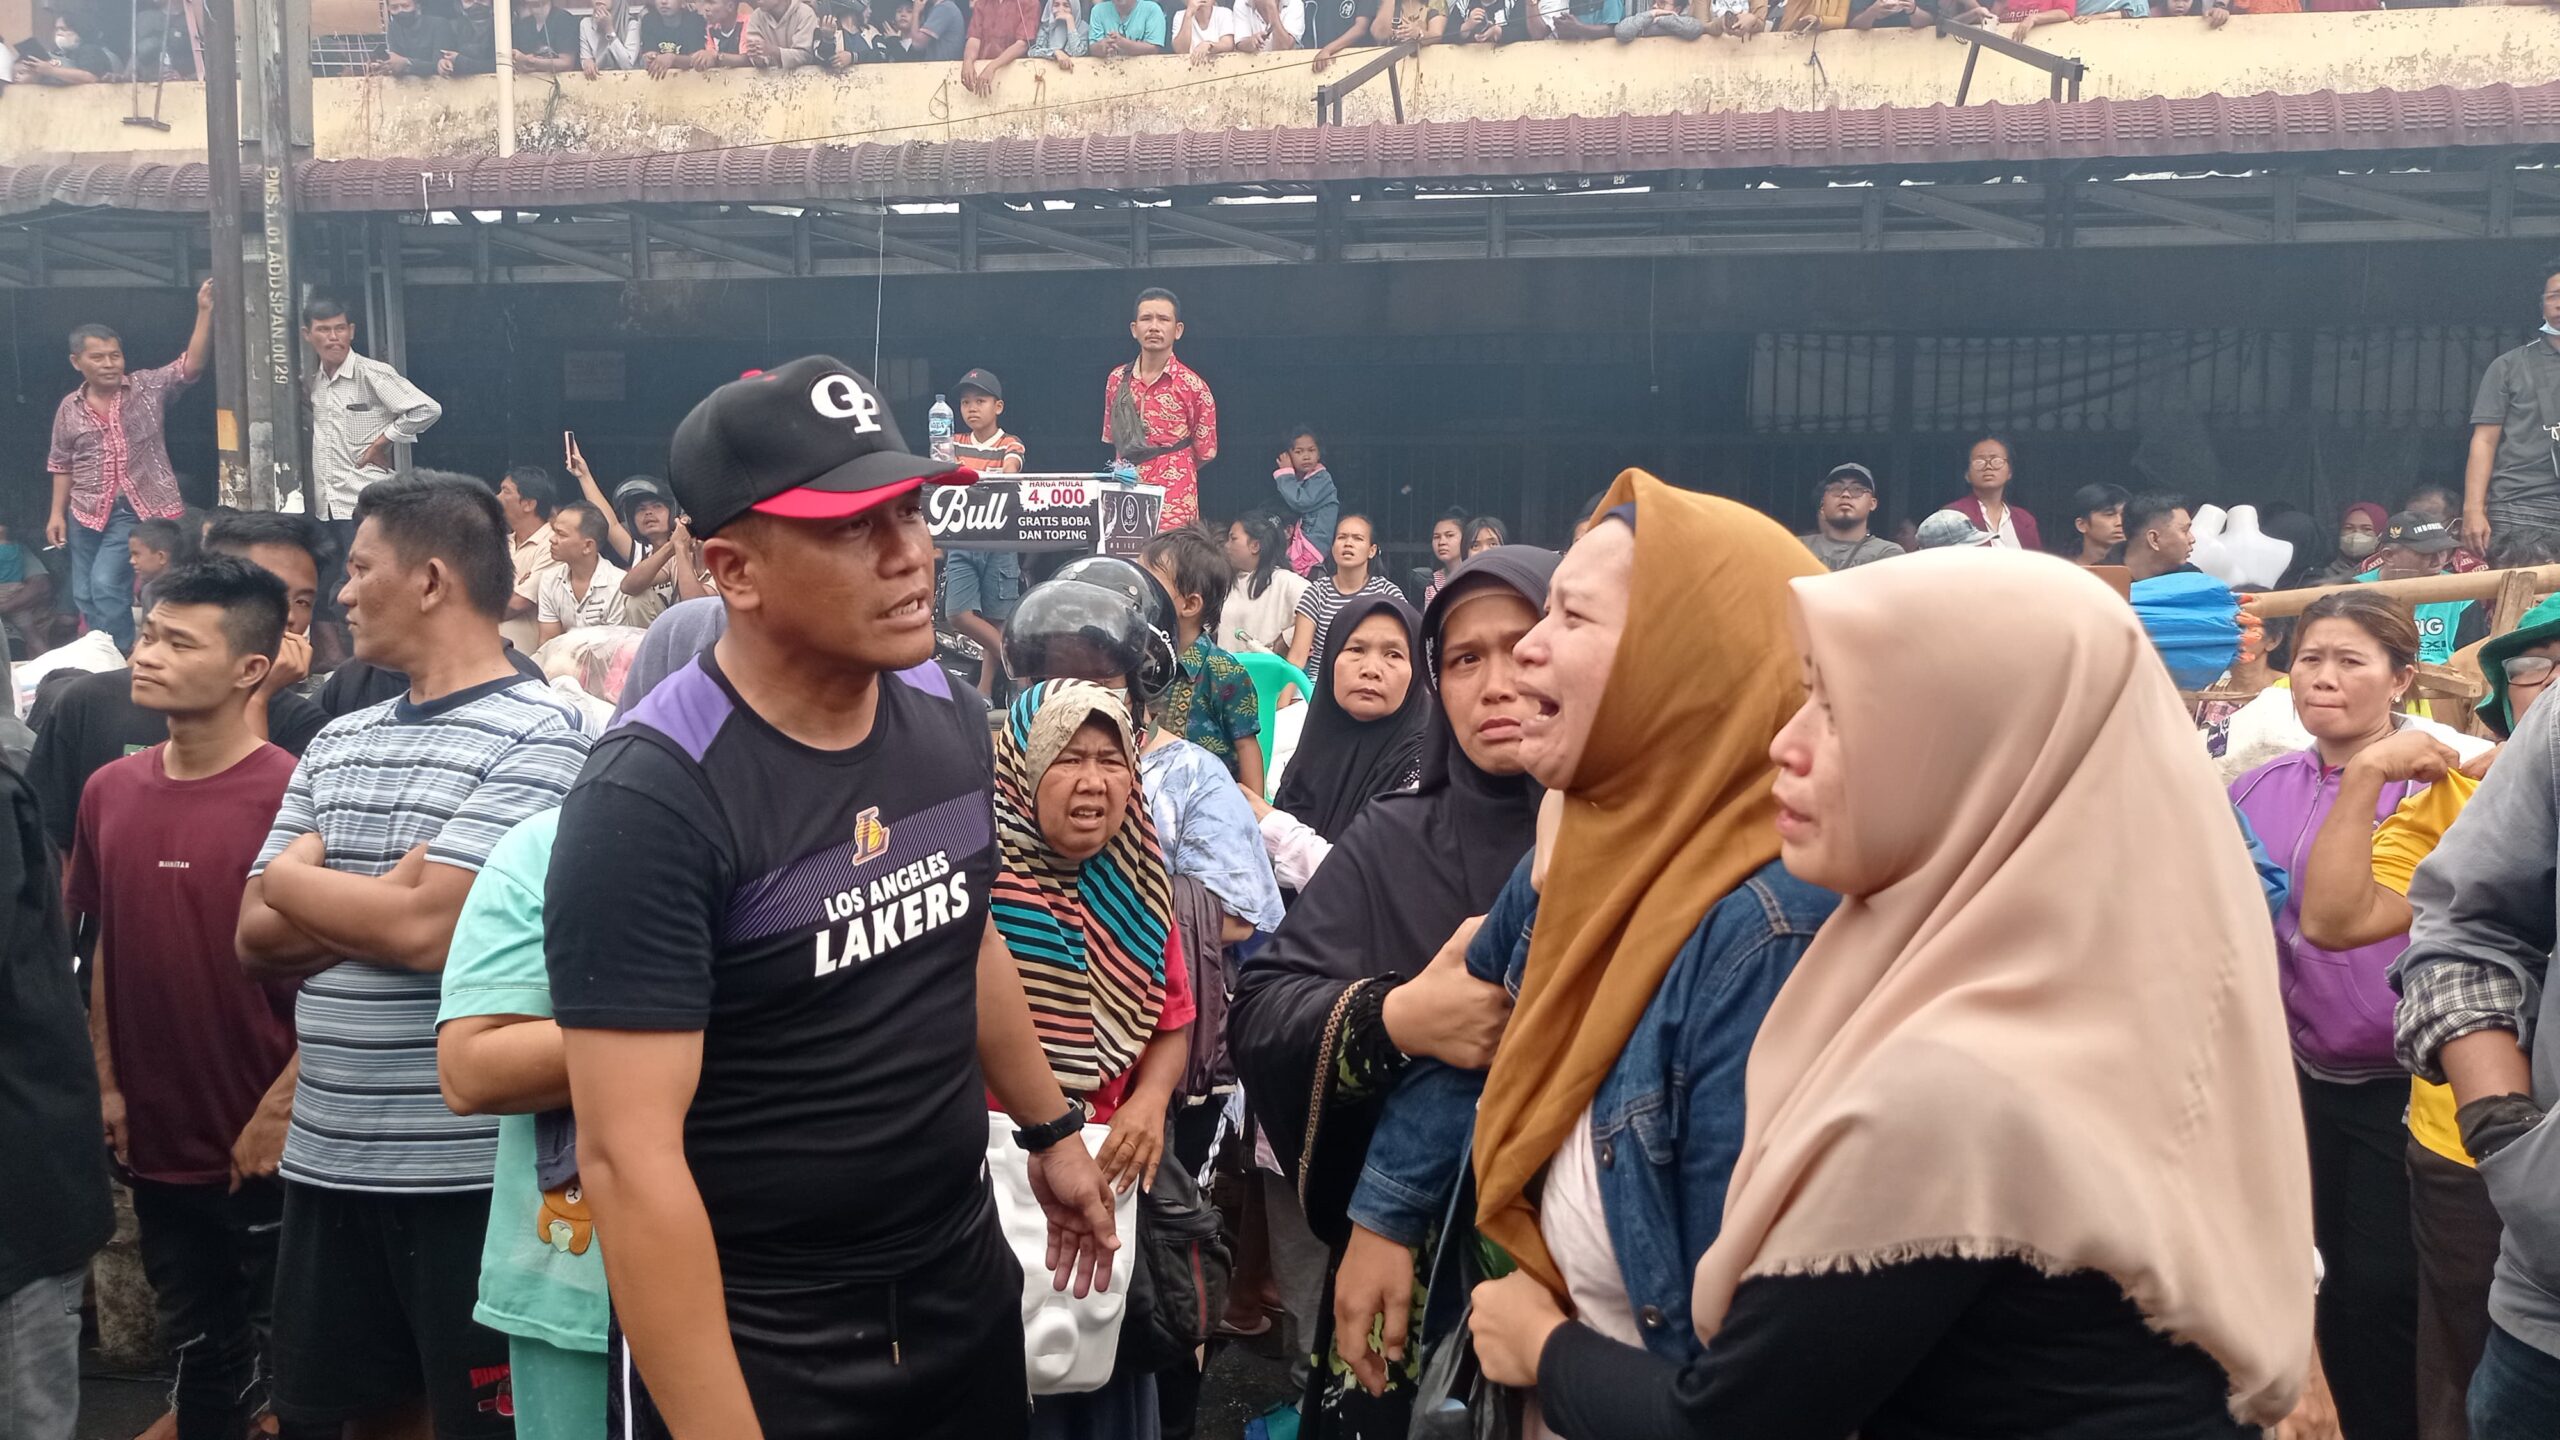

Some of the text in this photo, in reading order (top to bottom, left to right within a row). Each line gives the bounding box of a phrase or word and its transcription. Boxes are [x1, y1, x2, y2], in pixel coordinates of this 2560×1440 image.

[926, 484, 1009, 536] Bull
[1017, 516, 1092, 528] GRATIS BOBA
[1018, 529, 1088, 541] DAN TOPING
[824, 850, 950, 923] LOS ANGELES
[814, 871, 970, 978] LAKERS
